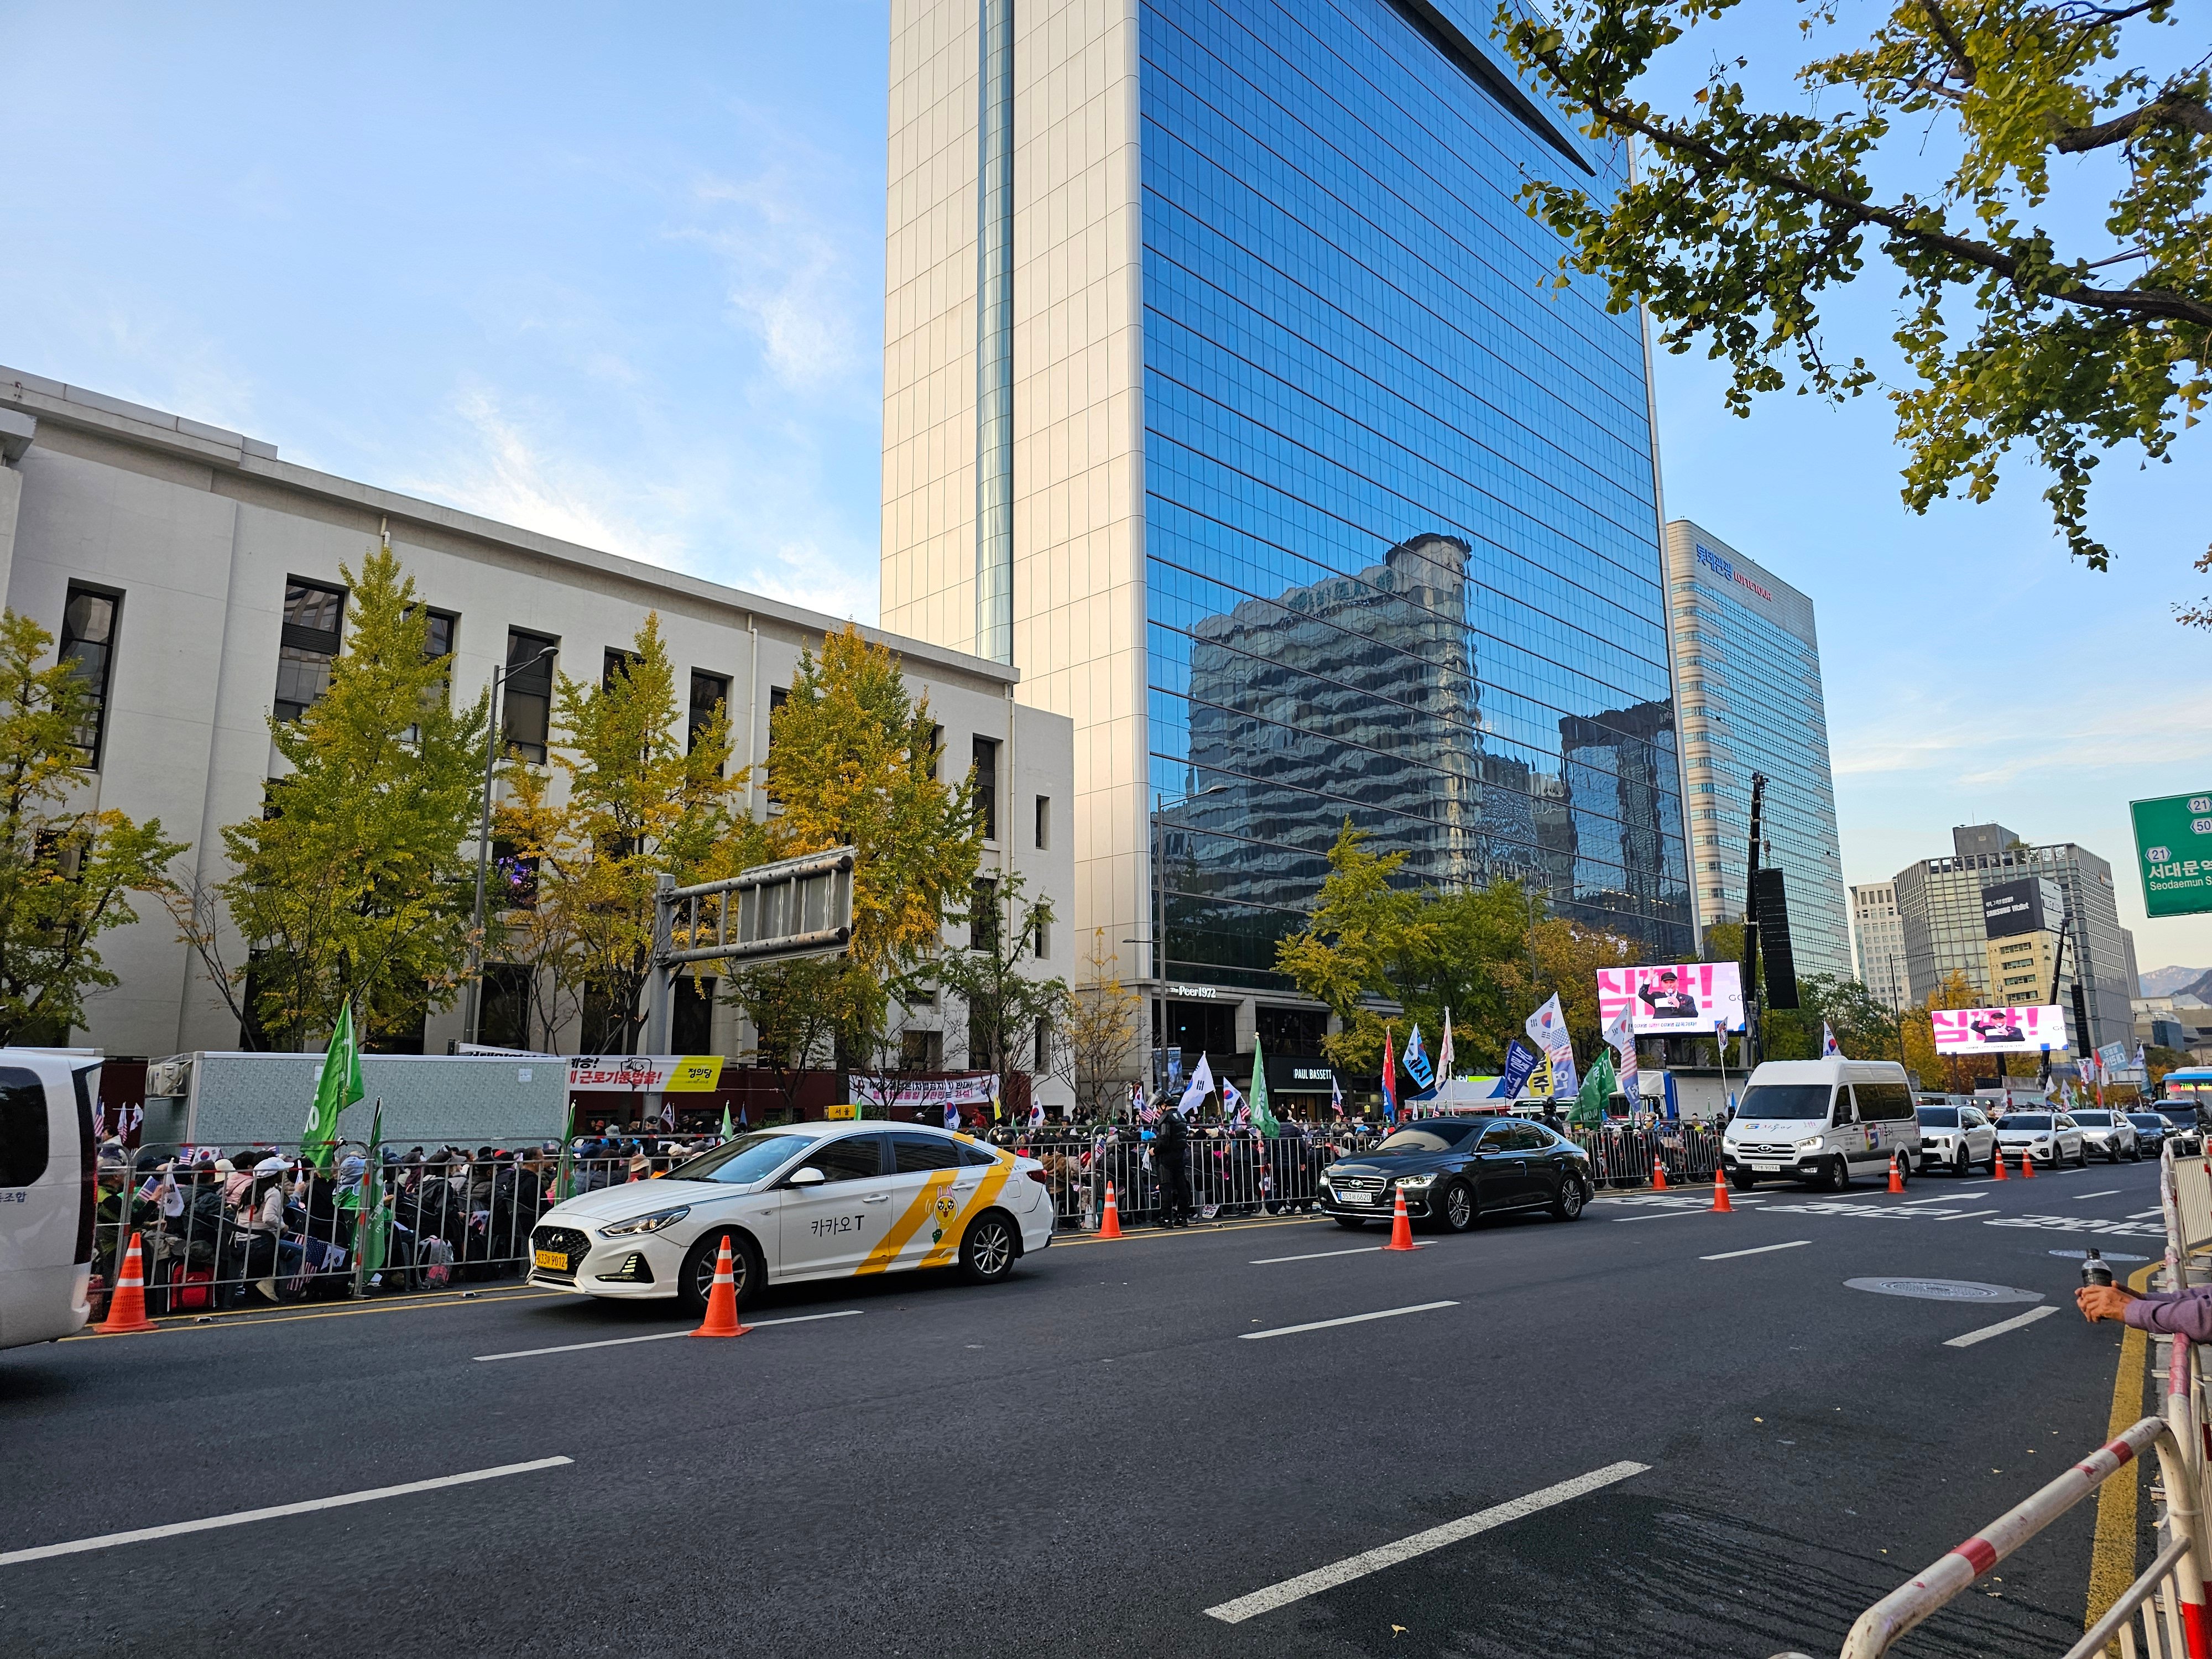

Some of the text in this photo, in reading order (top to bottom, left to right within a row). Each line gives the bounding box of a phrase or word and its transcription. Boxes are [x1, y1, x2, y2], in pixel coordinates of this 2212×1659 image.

[2193, 800, 2208, 811] 21
[2197, 821, 2211, 832] 50
[2152, 849, 2165, 860] 21
[2150, 875, 2212, 891] Seodaemun S
[1178, 985, 1216, 998] Peer1972
[579, 1071, 662, 1084] 근로기준법을!
[688, 1068, 713, 1078] 정의당
[1294, 1068, 1332, 1079] PAUL BASSETT
[834, 1107, 850, 1116] 서울
[0, 1191, 28, 1203] 조합
[811, 1215, 864, 1237] 카카오 T
[551, 1255, 565, 1267] 9012
